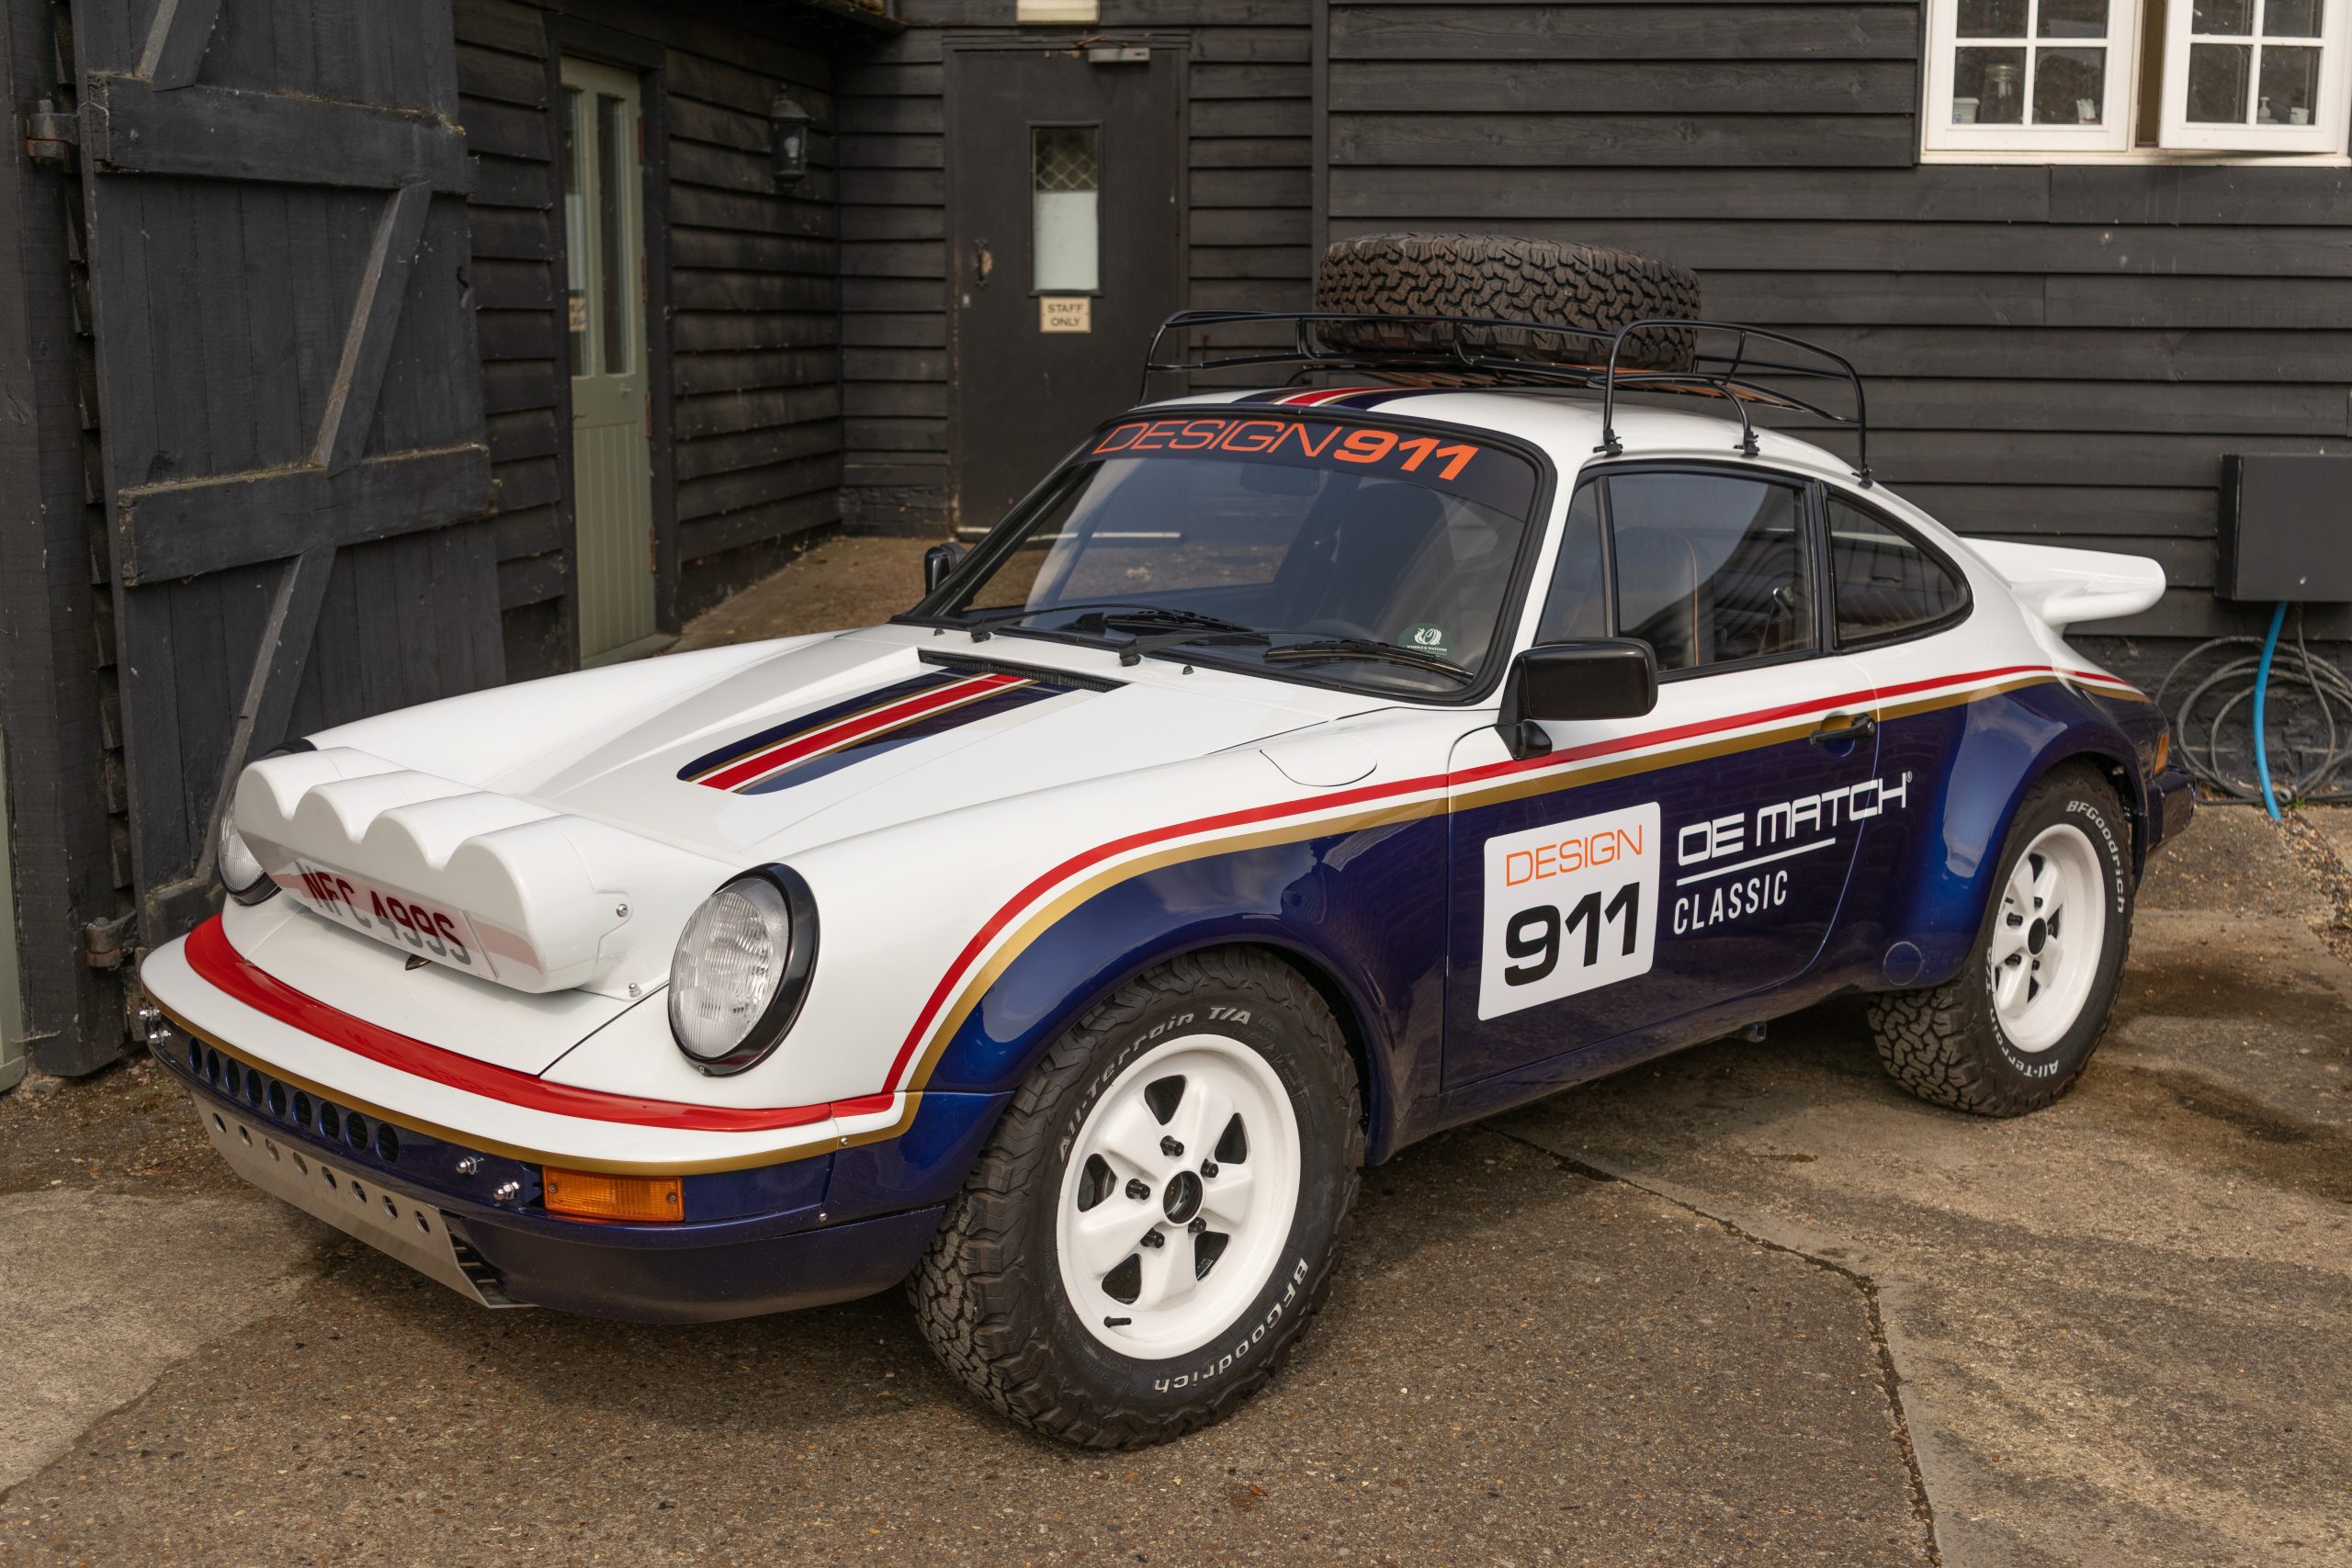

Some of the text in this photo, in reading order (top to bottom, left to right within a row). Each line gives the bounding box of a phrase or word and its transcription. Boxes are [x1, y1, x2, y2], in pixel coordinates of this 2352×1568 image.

[1047, 303, 1084, 313] STAFF
[1050, 317, 1080, 327] ONLY
[1091, 419, 1480, 481] DESIGN 911
[1506, 824, 1643, 887] DESIGN
[1678, 812, 1745, 866] OE
[2065, 800, 2125, 914] BFGoodrich
[294, 860, 472, 965] NFC 499S
[1504, 881, 1641, 987] 911
[1673, 870, 1788, 935] CLASSIC
[1059, 1007, 1252, 1164] All-Terrain T/A
[1153, 1258, 1309, 1393] BFGoodrich
